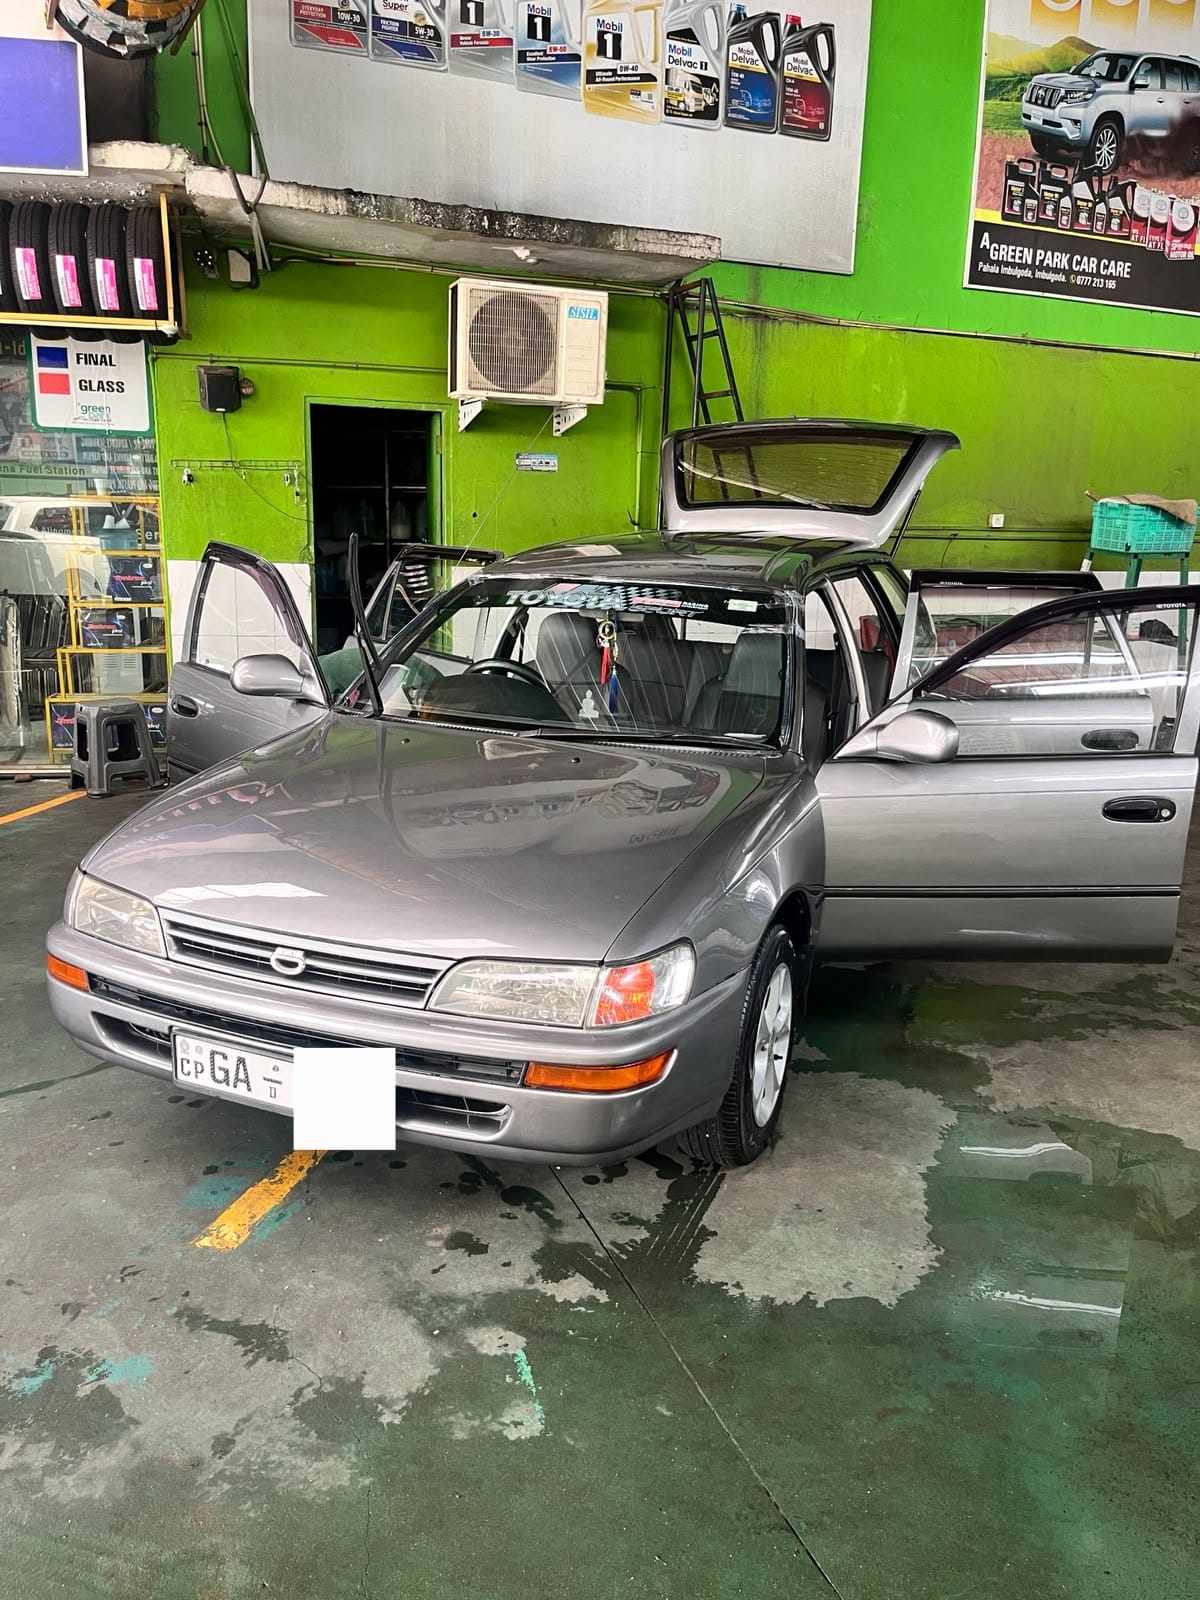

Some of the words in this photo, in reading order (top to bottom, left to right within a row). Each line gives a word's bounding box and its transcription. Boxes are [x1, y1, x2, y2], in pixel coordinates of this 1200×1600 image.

[383, 0, 408, 10] Super
[528, 4, 552, 16] Mobil
[338, 12, 360, 22] 10W-30
[415, 27, 434, 37] 5W-30
[534, 17, 543, 40] 1
[597, 18, 623, 33] Mobil
[604, 33, 614, 58] 1
[668, 44, 692, 57] Mobil
[738, 47, 754, 55] Mobil
[668, 55, 698, 69] Delvac
[731, 53, 759, 66] Delvac
[793, 57, 808, 65] Mobil
[786, 63, 813, 75] Delvac
[1036, 249, 1070, 270] PARK
[1072, 254, 1097, 273] CAR
[1100, 259, 1132, 278] CARE
[978, 262, 999, 274] Pahala
[1092, 278, 1104, 288] 213
[569, 306, 596, 320] SISIL
[76, 352, 117, 367] FINAL
[79, 379, 125, 393] GLASS
[81, 404, 111, 415] green
[20, 464, 42, 473] Fuel
[47, 464, 85, 476] Station
[180, 1058, 204, 1078] CP
[210, 1049, 252, 1092] GA
